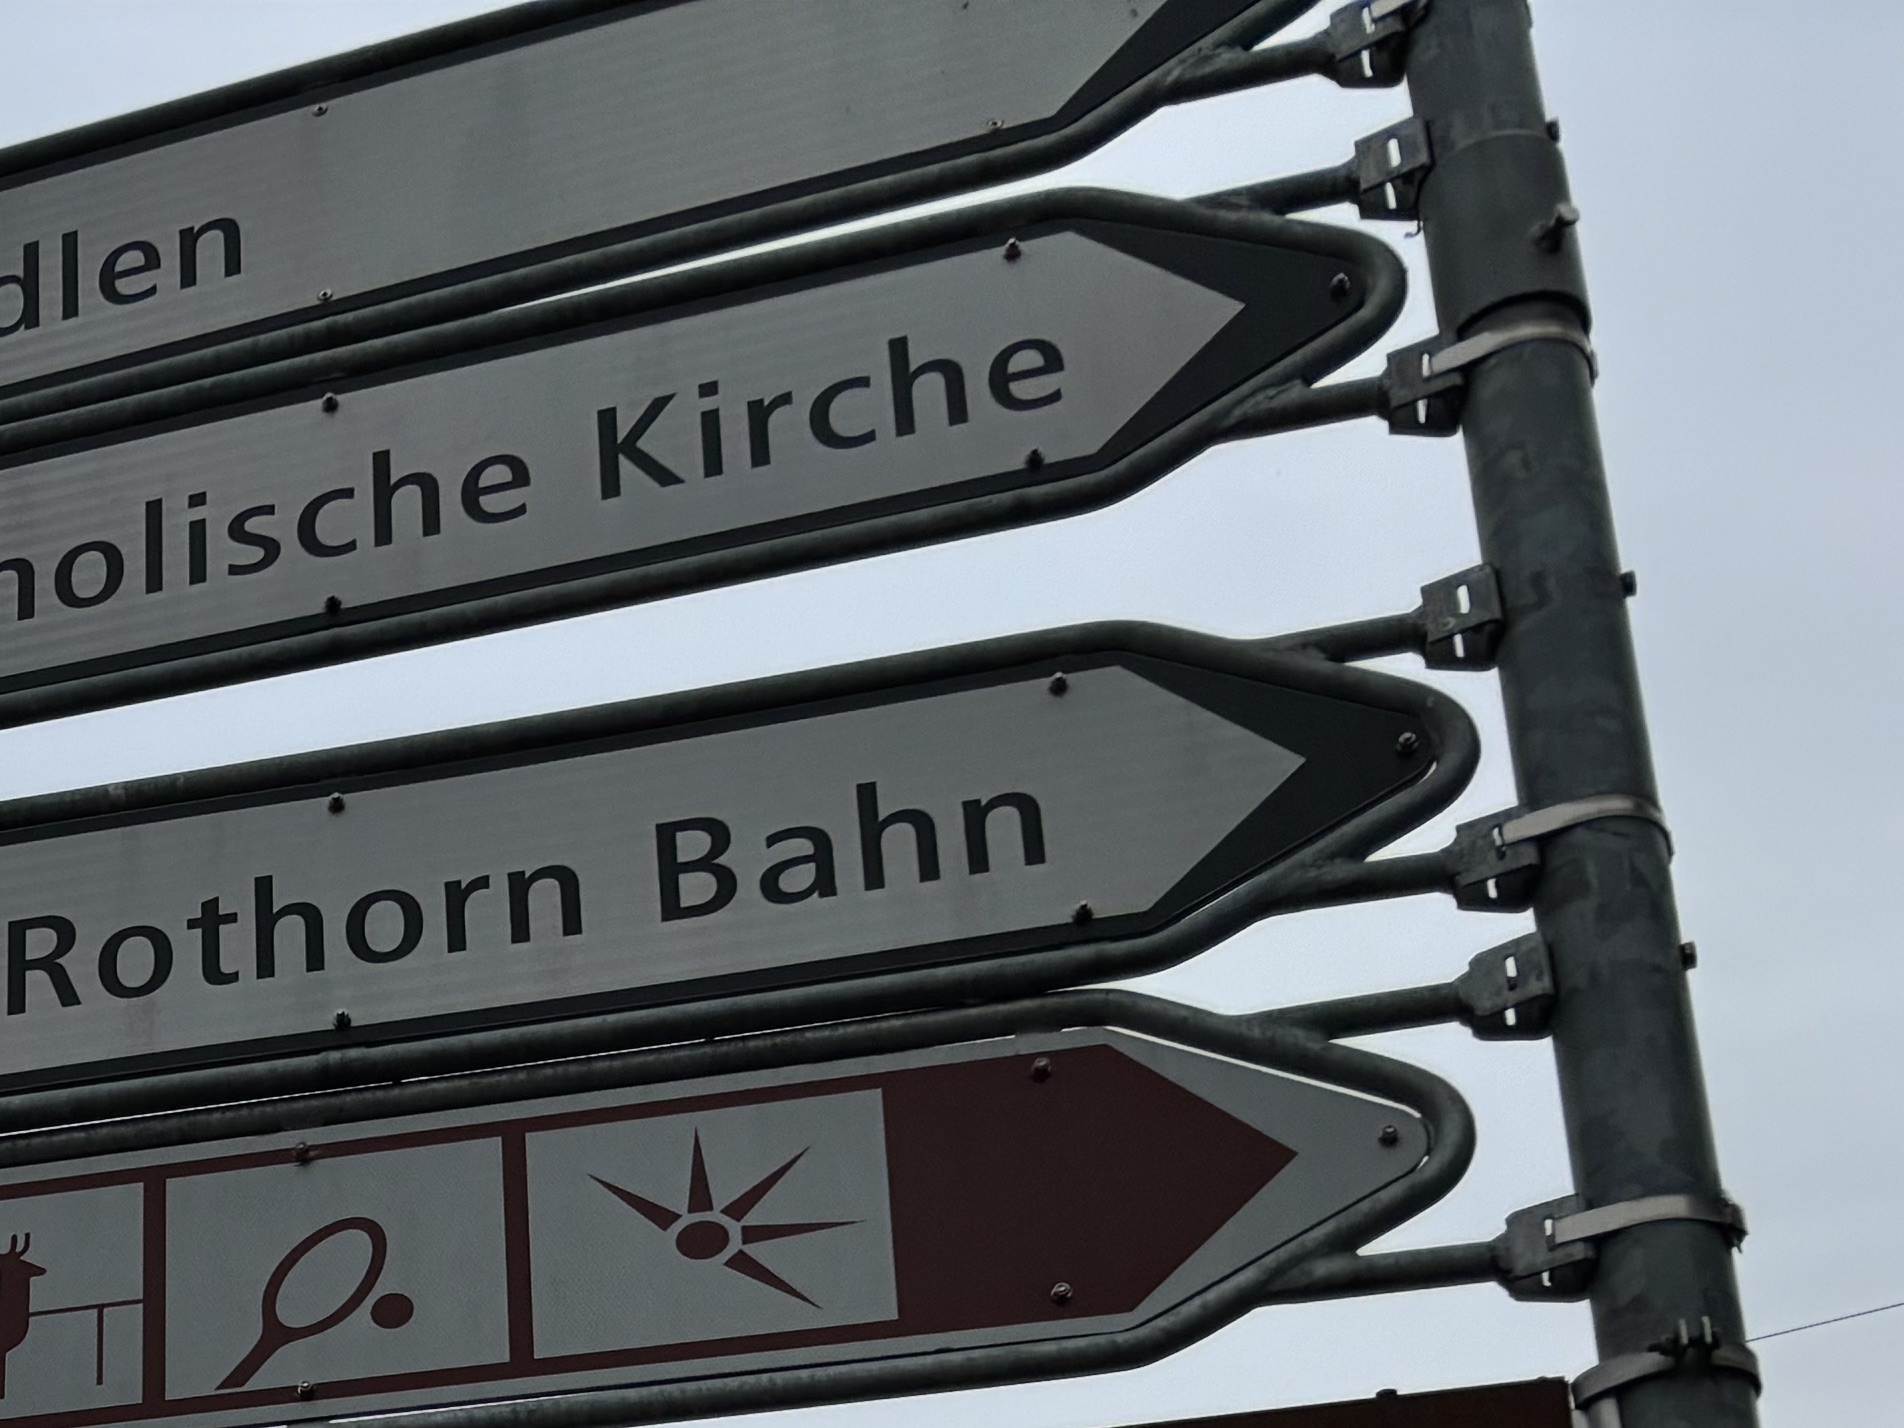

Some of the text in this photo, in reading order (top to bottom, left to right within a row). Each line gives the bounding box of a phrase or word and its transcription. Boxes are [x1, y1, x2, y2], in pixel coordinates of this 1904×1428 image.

[597, 339, 1064, 500] Kirche
[7, 865, 582, 1015] Rothorn
[656, 782, 1046, 922] Bahn
